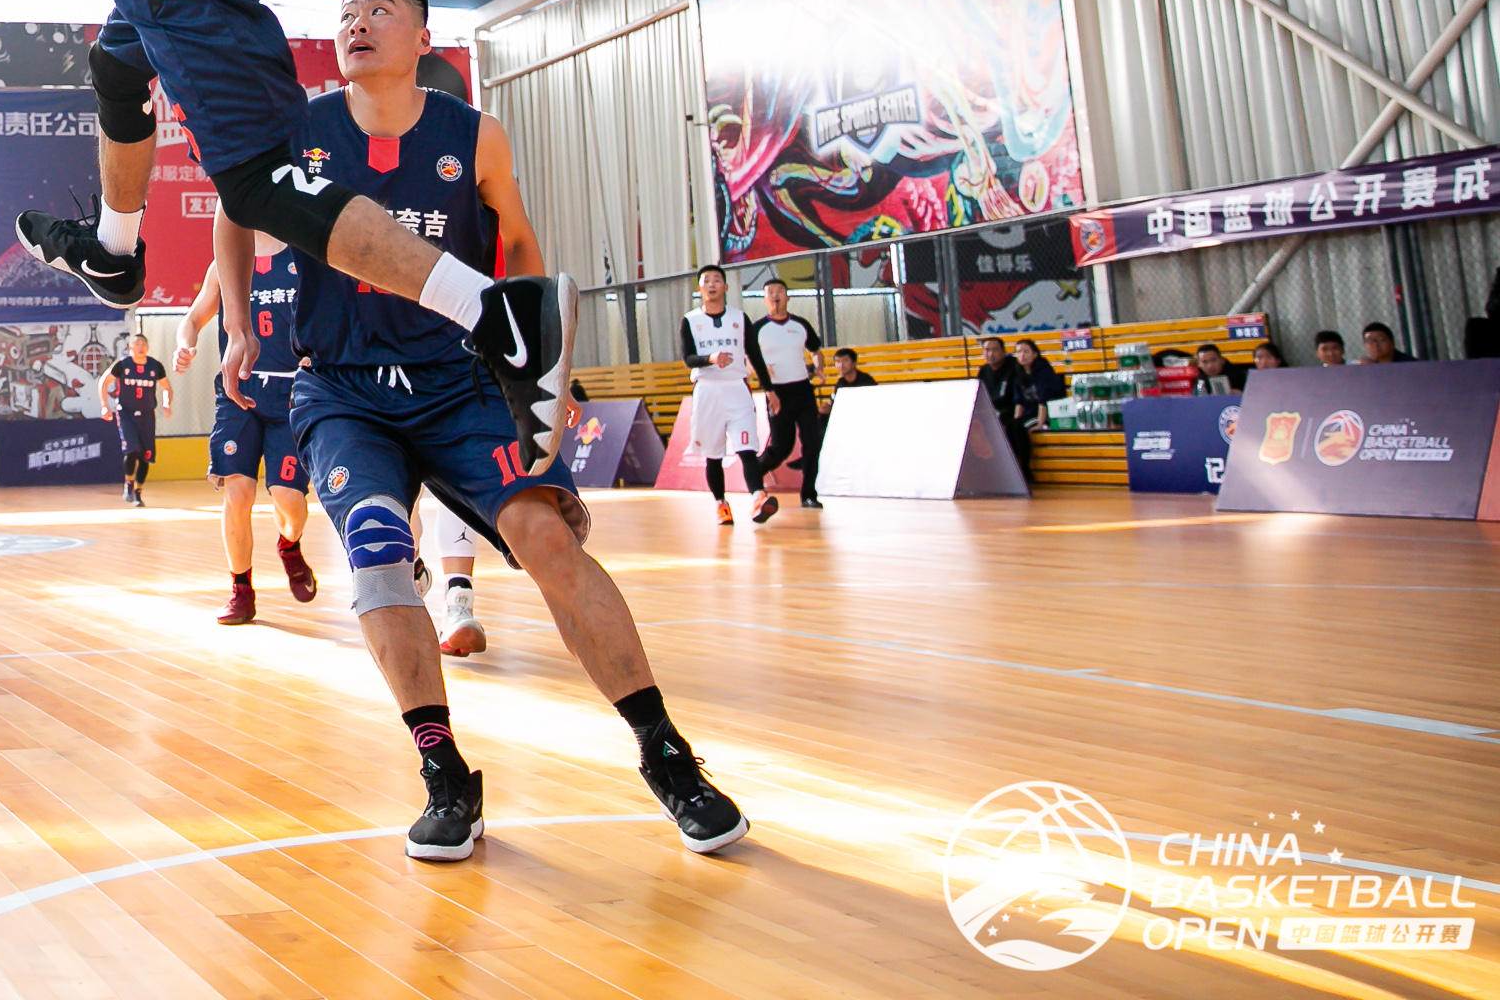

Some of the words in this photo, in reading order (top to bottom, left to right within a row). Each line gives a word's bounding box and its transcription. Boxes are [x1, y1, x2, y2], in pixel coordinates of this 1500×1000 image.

[382, 207, 448, 238] 奈吉
[258, 310, 274, 337] 6
[1368, 424, 1408, 436] CHINA
[1364, 437, 1450, 449] BASKETBALL
[1359, 450, 1394, 461] OPEN
[280, 456, 297, 481] 6
